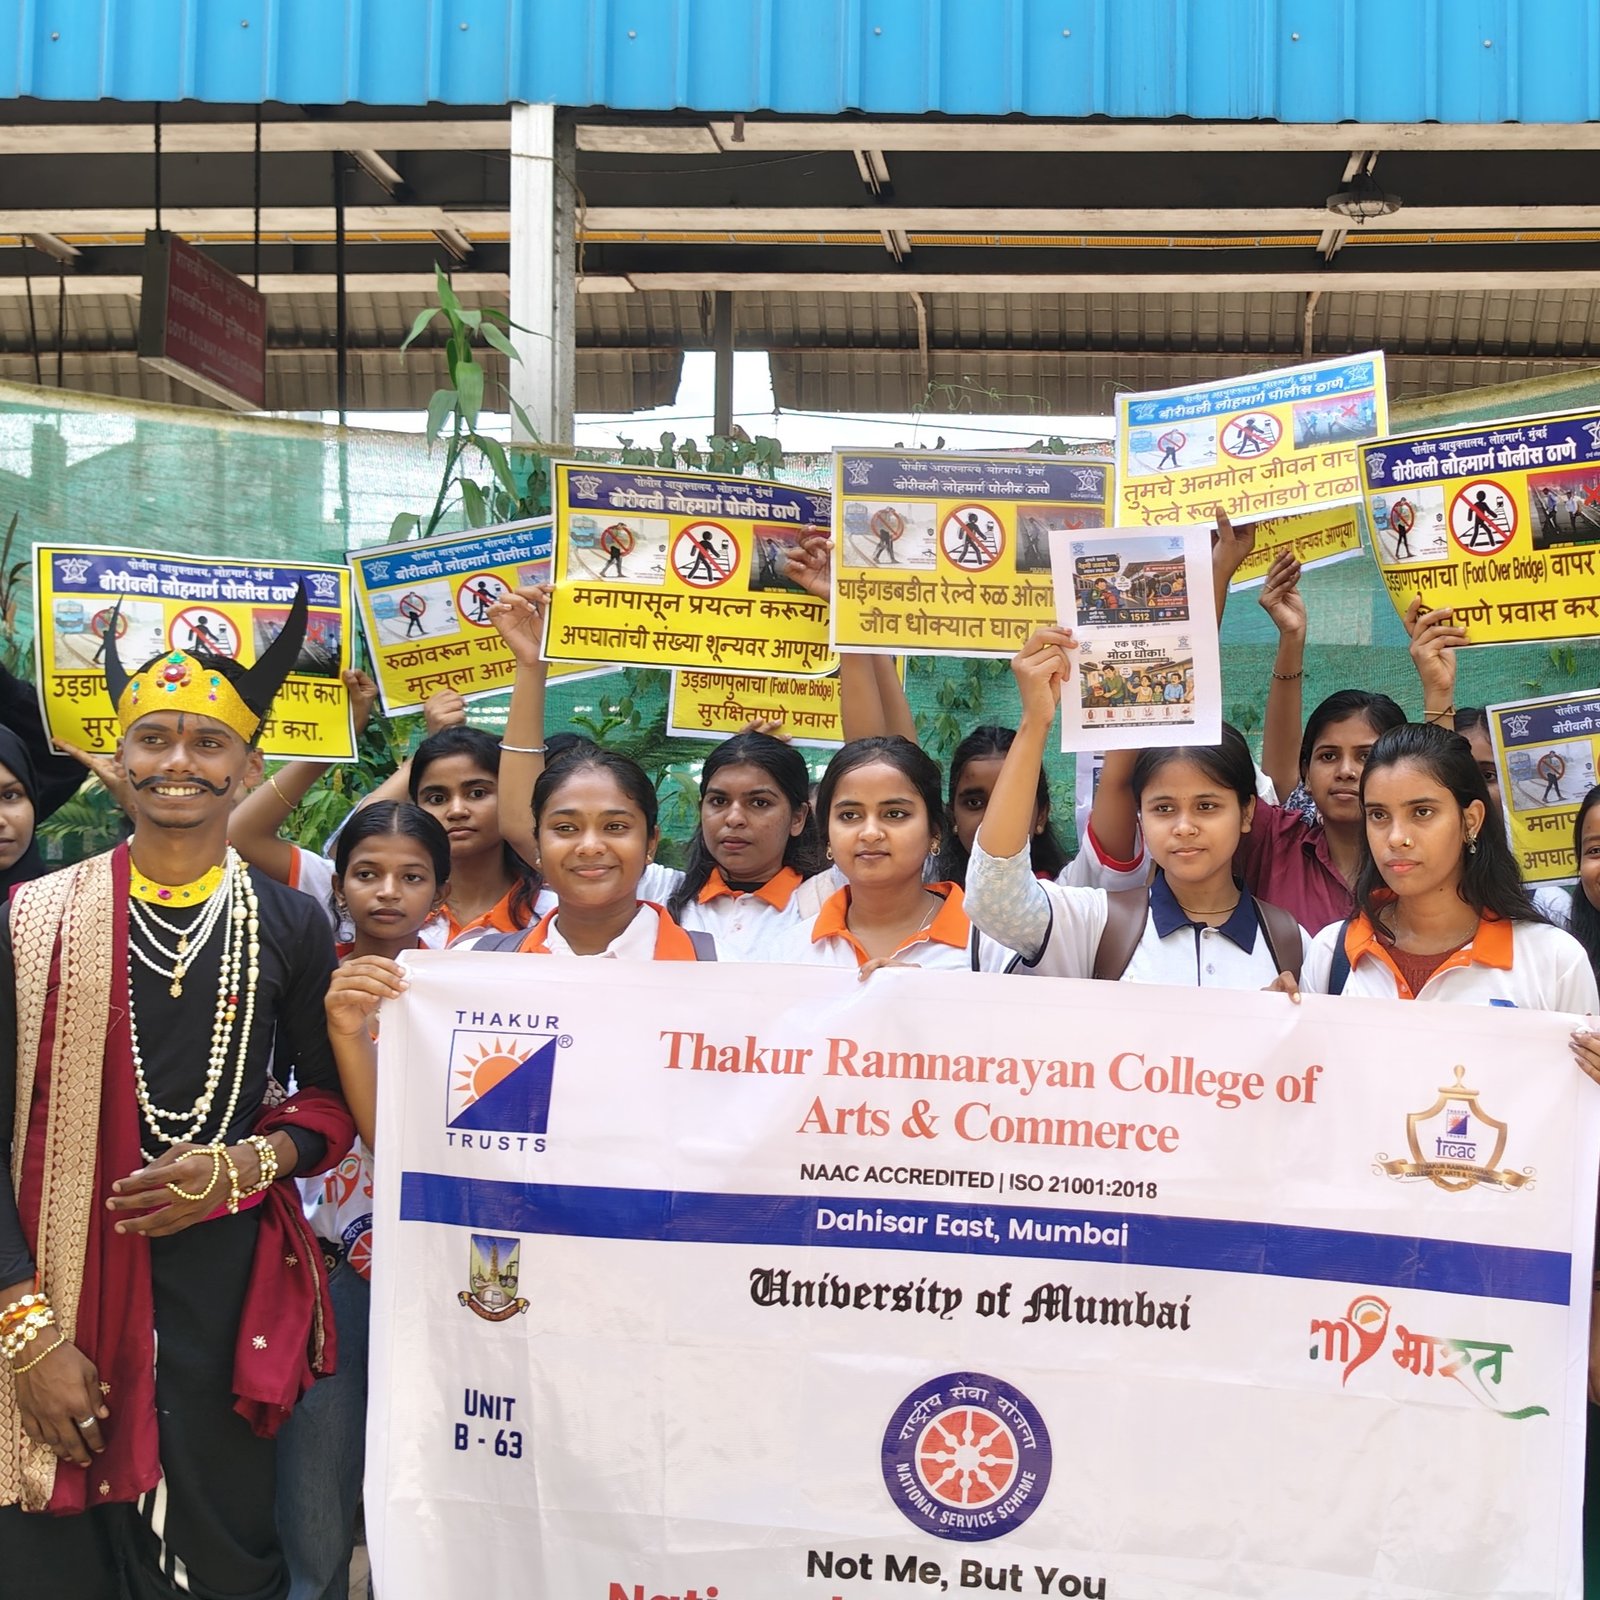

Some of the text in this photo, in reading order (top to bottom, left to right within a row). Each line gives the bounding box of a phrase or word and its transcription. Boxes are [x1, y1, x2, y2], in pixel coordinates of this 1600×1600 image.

[1158, 377, 1344, 420] बोरीवली लोहमार्ग पोलीस ठाणे
[1392, 436, 1577, 482] बोरीवली लोहमार्ग पोलीस ठाणे
[1124, 476, 1174, 510] तुमचे
[1178, 465, 1256, 494] अनमोल
[1260, 454, 1315, 480] जीवन
[609, 488, 800, 520] बोरीवली लोहमार्ग पोलीस ठाणे
[1141, 502, 1182, 526] रेल्वे
[1222, 480, 1308, 516] ओलांडणे
[394, 560, 443, 581] बोरीवली
[446, 553, 490, 572] लोहमार्ग
[492, 547, 530, 566] पोलीस
[1463, 561, 1487, 590] (Foot
[1489, 559, 1512, 582] Over
[1514, 553, 1548, 586] Bridge)
[1550, 550, 1596, 577] वापर
[100, 568, 158, 594] बोरीवली
[162, 575, 218, 600] लोहमार्ग
[222, 579, 268, 602] पोलीस
[838, 572, 936, 606] घाईगडबडीत
[940, 576, 977, 605] रेल्वे
[573, 588, 682, 620] मनापासून
[688, 594, 755, 617] प्रयत्न
[1130, 613, 1150, 622] 1512
[1498, 600, 1558, 626] प्रवास
[860, 607, 901, 635] जीव
[905, 609, 987, 638] धोक्यात
[561, 622, 835, 669] अपघातांची संख्या शून्यवर आणूया!
[1107, 647, 1166, 660] मोठा धोका!
[1114, 640, 1128, 649] एक
[313, 683, 342, 705] करा
[770, 678, 789, 696] (Foot
[790, 680, 808, 696] Over
[809, 680, 834, 702] Bridge)
[792, 711, 838, 729] प्रवास
[1552, 718, 1592, 734] बोरीवली
[1555, 704, 1580, 717] पोलीस
[282, 720, 323, 741] करा.
[456, 1010, 560, 1030] THAKUR
[660, 1030, 1324, 1109] Thakur Ramnarayan College of
[446, 1132, 546, 1152] TRUSTS
[796, 1096, 1180, 1154] Arts & Commerce
[1436, 1137, 1476, 1159] trcac
[800, 1163, 859, 1182] NAAC
[864, 1166, 994, 1190] ACCREDITED
[1009, 1173, 1044, 1192] ISO
[1049, 1176, 1158, 1199] 21001:2018
[816, 1208, 1128, 1247] Dahisar East, Mumbai
[750, 1267, 1192, 1331] University of Mumbai
[1392, 1324, 1549, 1420] भारत
[464, 1388, 516, 1422] UNIT
[899, 1382, 1036, 1450] राष्ट्रीय सेवा योजना
[455, 1423, 468, 1450] B
[495, 1429, 522, 1458] 63
[896, 1463, 1036, 1528] NATIONAL SERVICE SCHEME
[806, 1550, 1107, 1599] Not Me, But You
